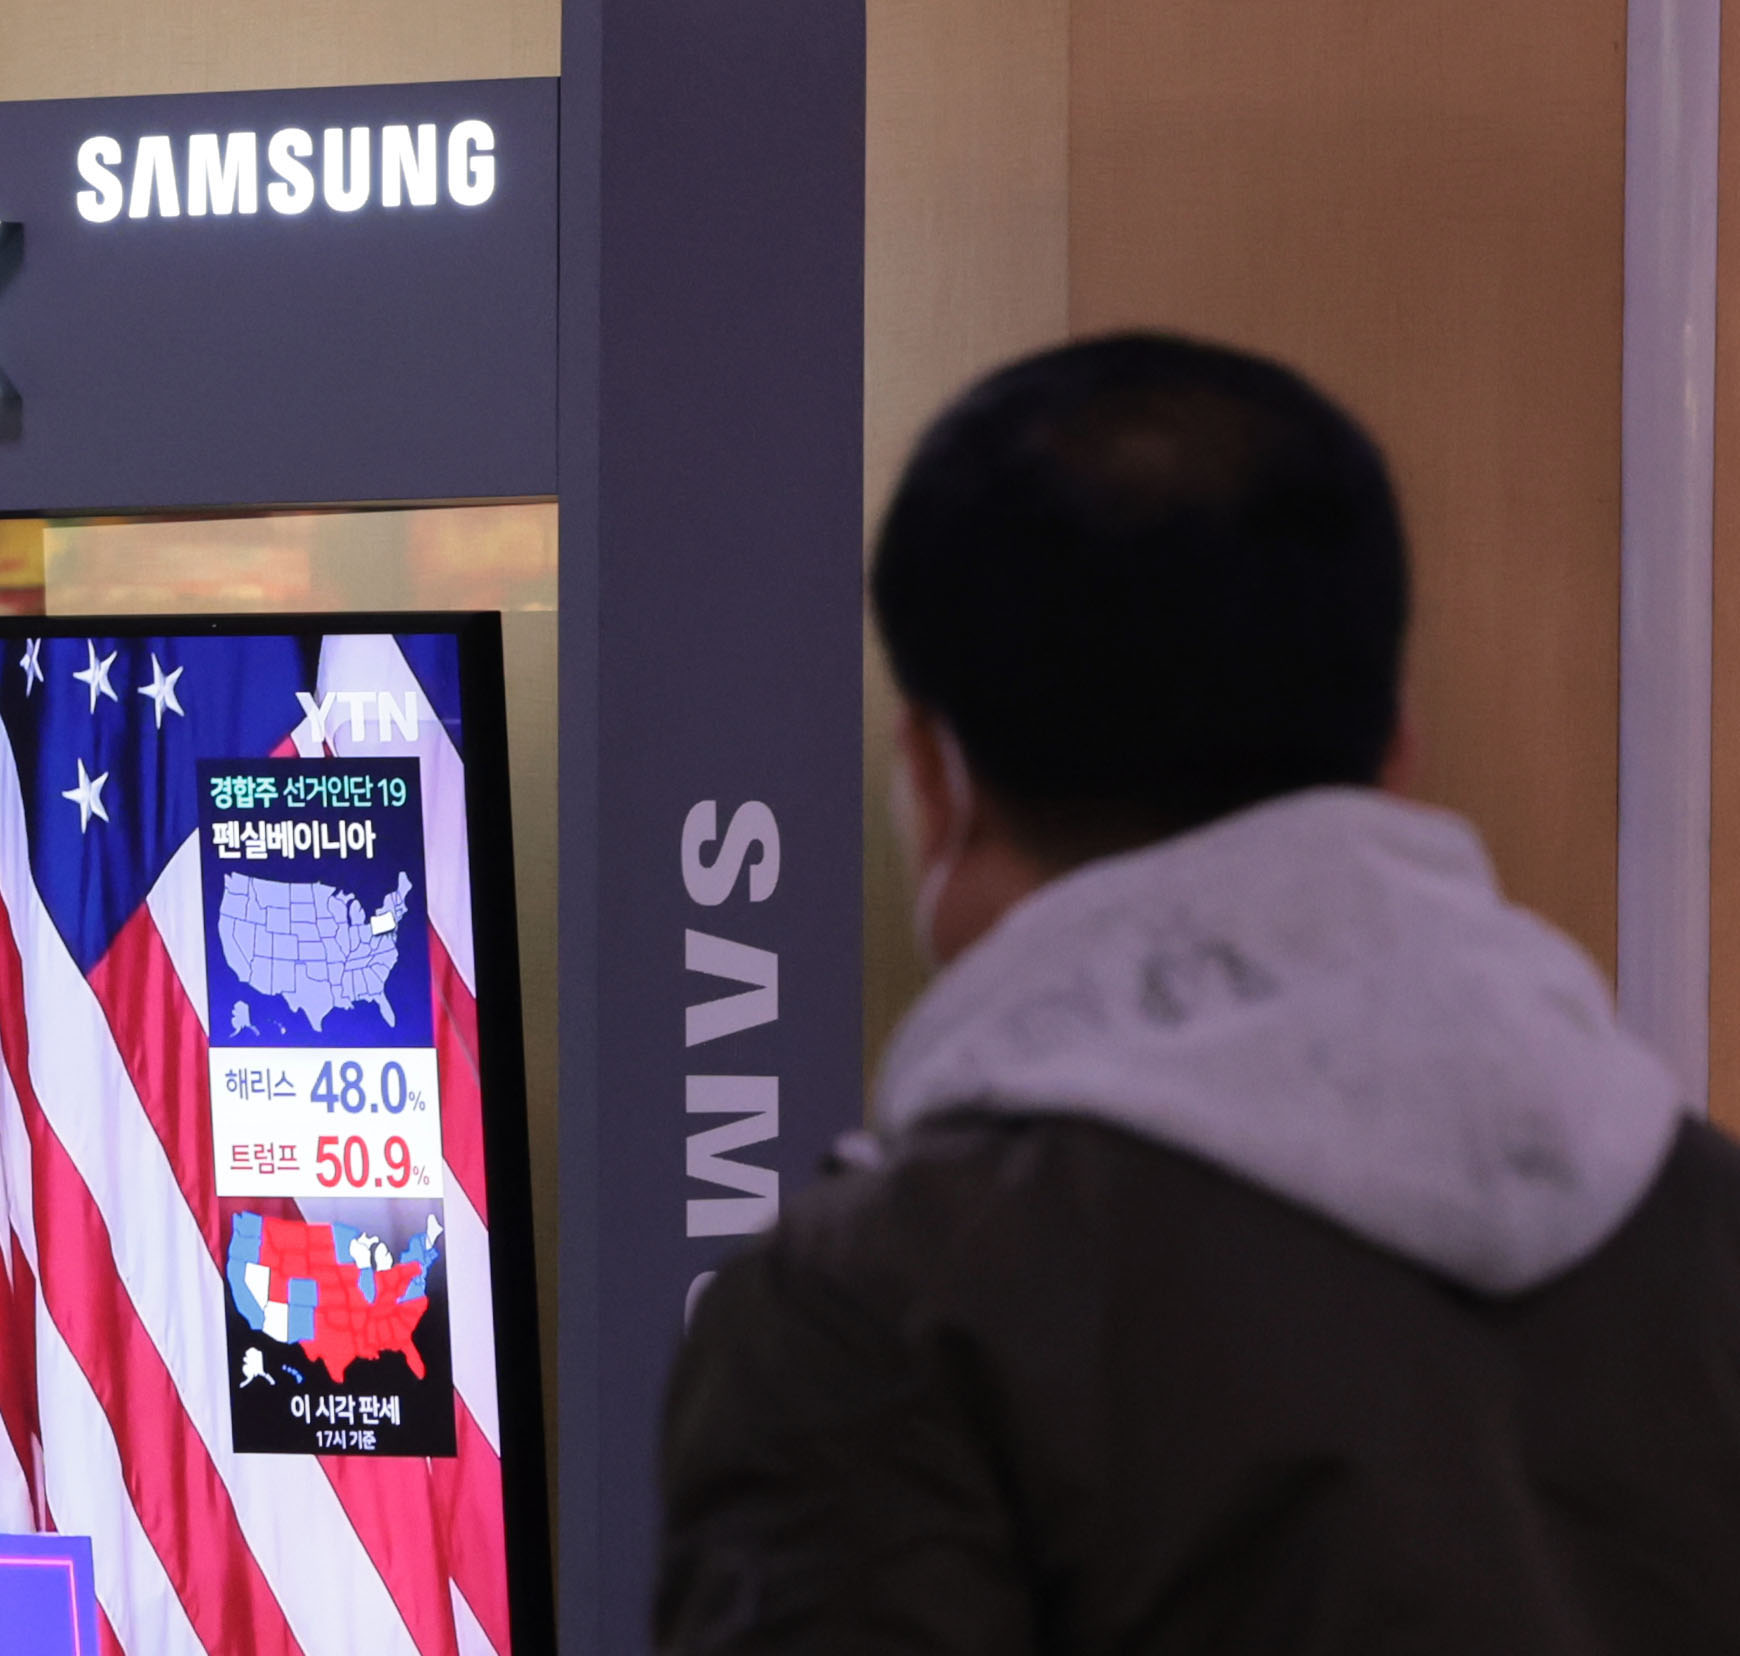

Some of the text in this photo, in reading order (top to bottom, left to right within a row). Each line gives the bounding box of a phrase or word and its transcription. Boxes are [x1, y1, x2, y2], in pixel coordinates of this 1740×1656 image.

[76, 119, 497, 223] SAMSUNG
[295, 691, 419, 743] YTN
[210, 775, 408, 809] 경합주 선거인단 19
[212, 820, 377, 860] 펜실베이니아
[224, 1068, 297, 1101] 해리스
[681, 799, 780, 1336] SAM
[230, 1143, 301, 1175] 트럼프
[290, 1393, 401, 1426] 이 시각 판세
[315, 1429, 377, 1450] 17시 기준
